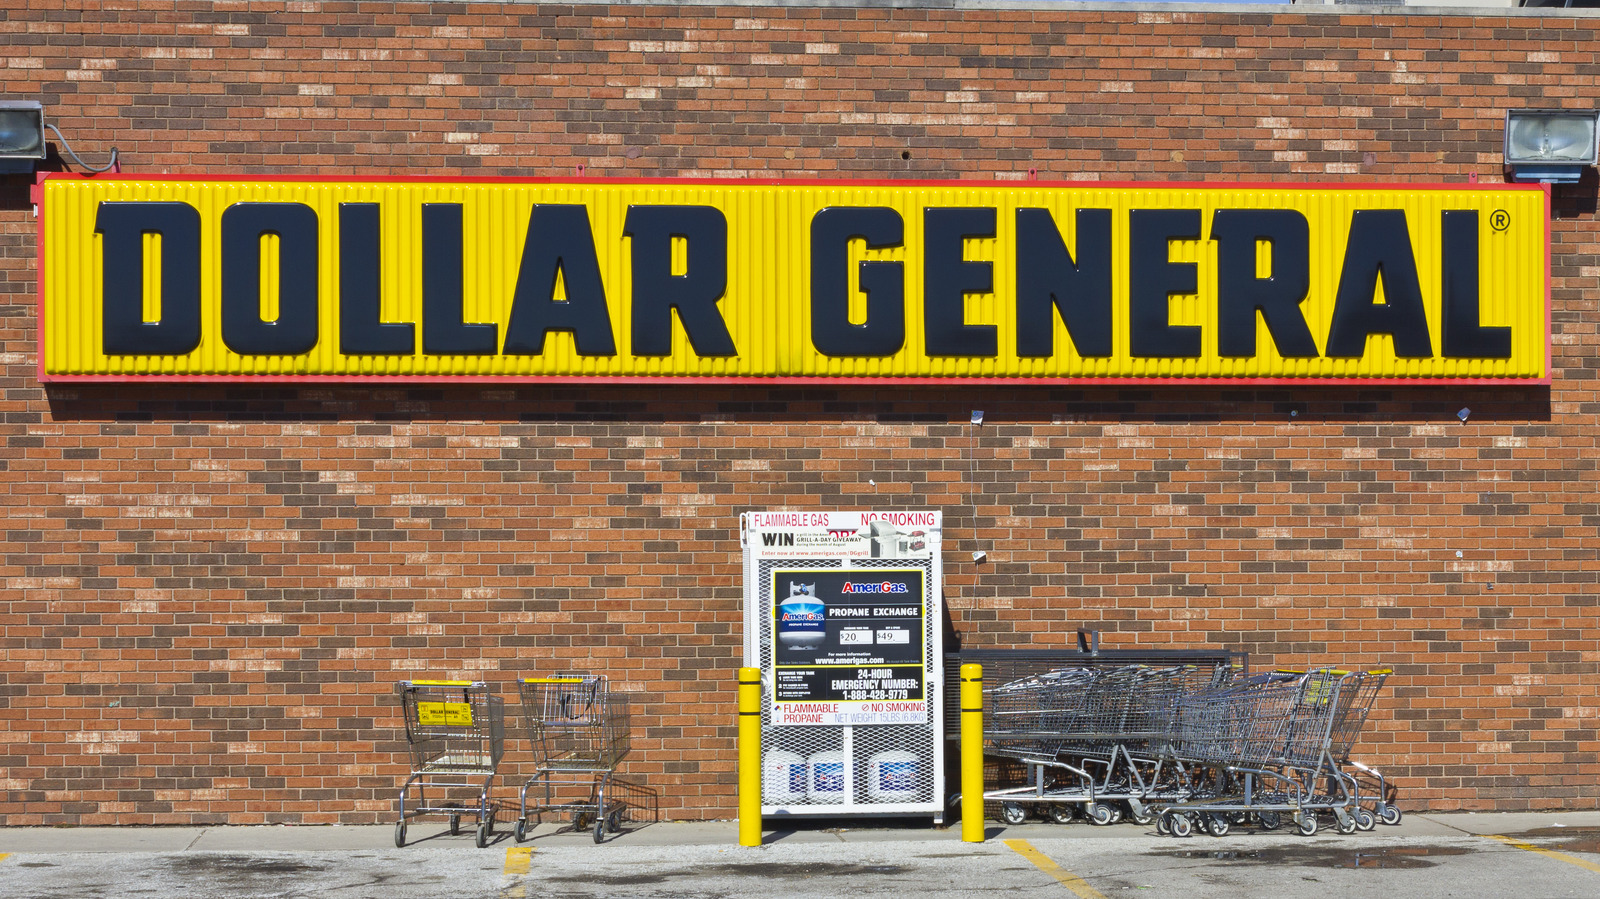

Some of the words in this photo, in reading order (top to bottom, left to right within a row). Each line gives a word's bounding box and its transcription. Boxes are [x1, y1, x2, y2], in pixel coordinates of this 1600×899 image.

[94, 201, 739, 358] DOLLAR
[810, 206, 1512, 359] GENERAL
[754, 513, 808, 527] FLAMMABLE
[810, 513, 829, 527] GAS
[761, 532, 794, 547] WIN
[841, 581, 907, 594] AmeriGas
[782, 612, 825, 621] AmeriGas
[829, 608, 870, 617] PROPANE
[873, 607, 918, 616] EXCHANGE
[815, 656, 884, 665] www.amerigas.com
[857, 668, 893, 679] 24-HOUR
[831, 679, 880, 690] EMERGENCY
[881, 679, 919, 689] NUMBER:
[843, 689, 908, 700] 1-888-428-9779
[783, 703, 839, 713] FLAMMABLE
[871, 703, 884, 712] NO
[885, 702, 925, 712] SMOKING
[783, 713, 824, 723] PROPANE
[834, 713, 848, 723] NET
[850, 713, 876, 723] WEIGHT
